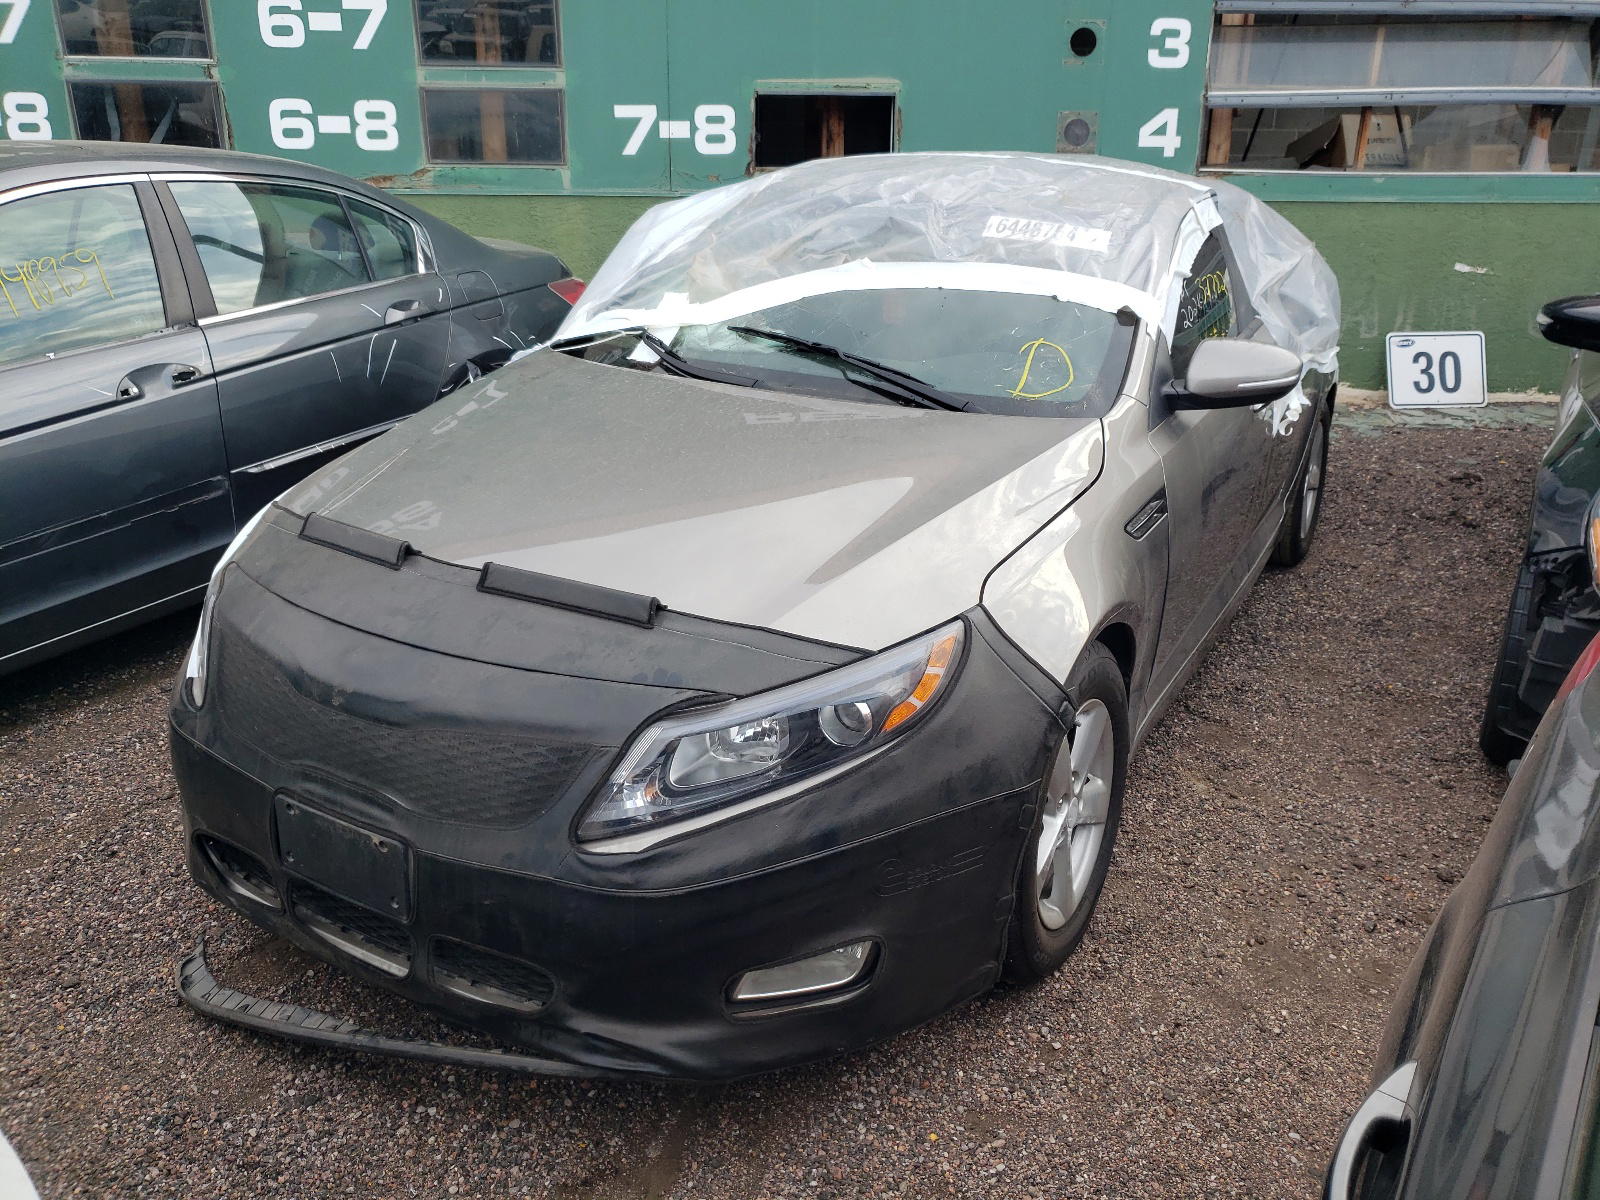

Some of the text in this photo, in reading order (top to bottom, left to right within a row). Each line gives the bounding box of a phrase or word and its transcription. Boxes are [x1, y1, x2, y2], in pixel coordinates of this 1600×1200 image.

[257, 0, 388, 50] 6-7
[1147, 17, 1192, 69] 3
[0, 91, 52, 141] 8
[268, 97, 399, 151] 6-8
[613, 104, 737, 156] 7-8
[1137, 108, 1181, 157] 4
[1005, 337, 1074, 399] D
[1412, 350, 1462, 395] 30
